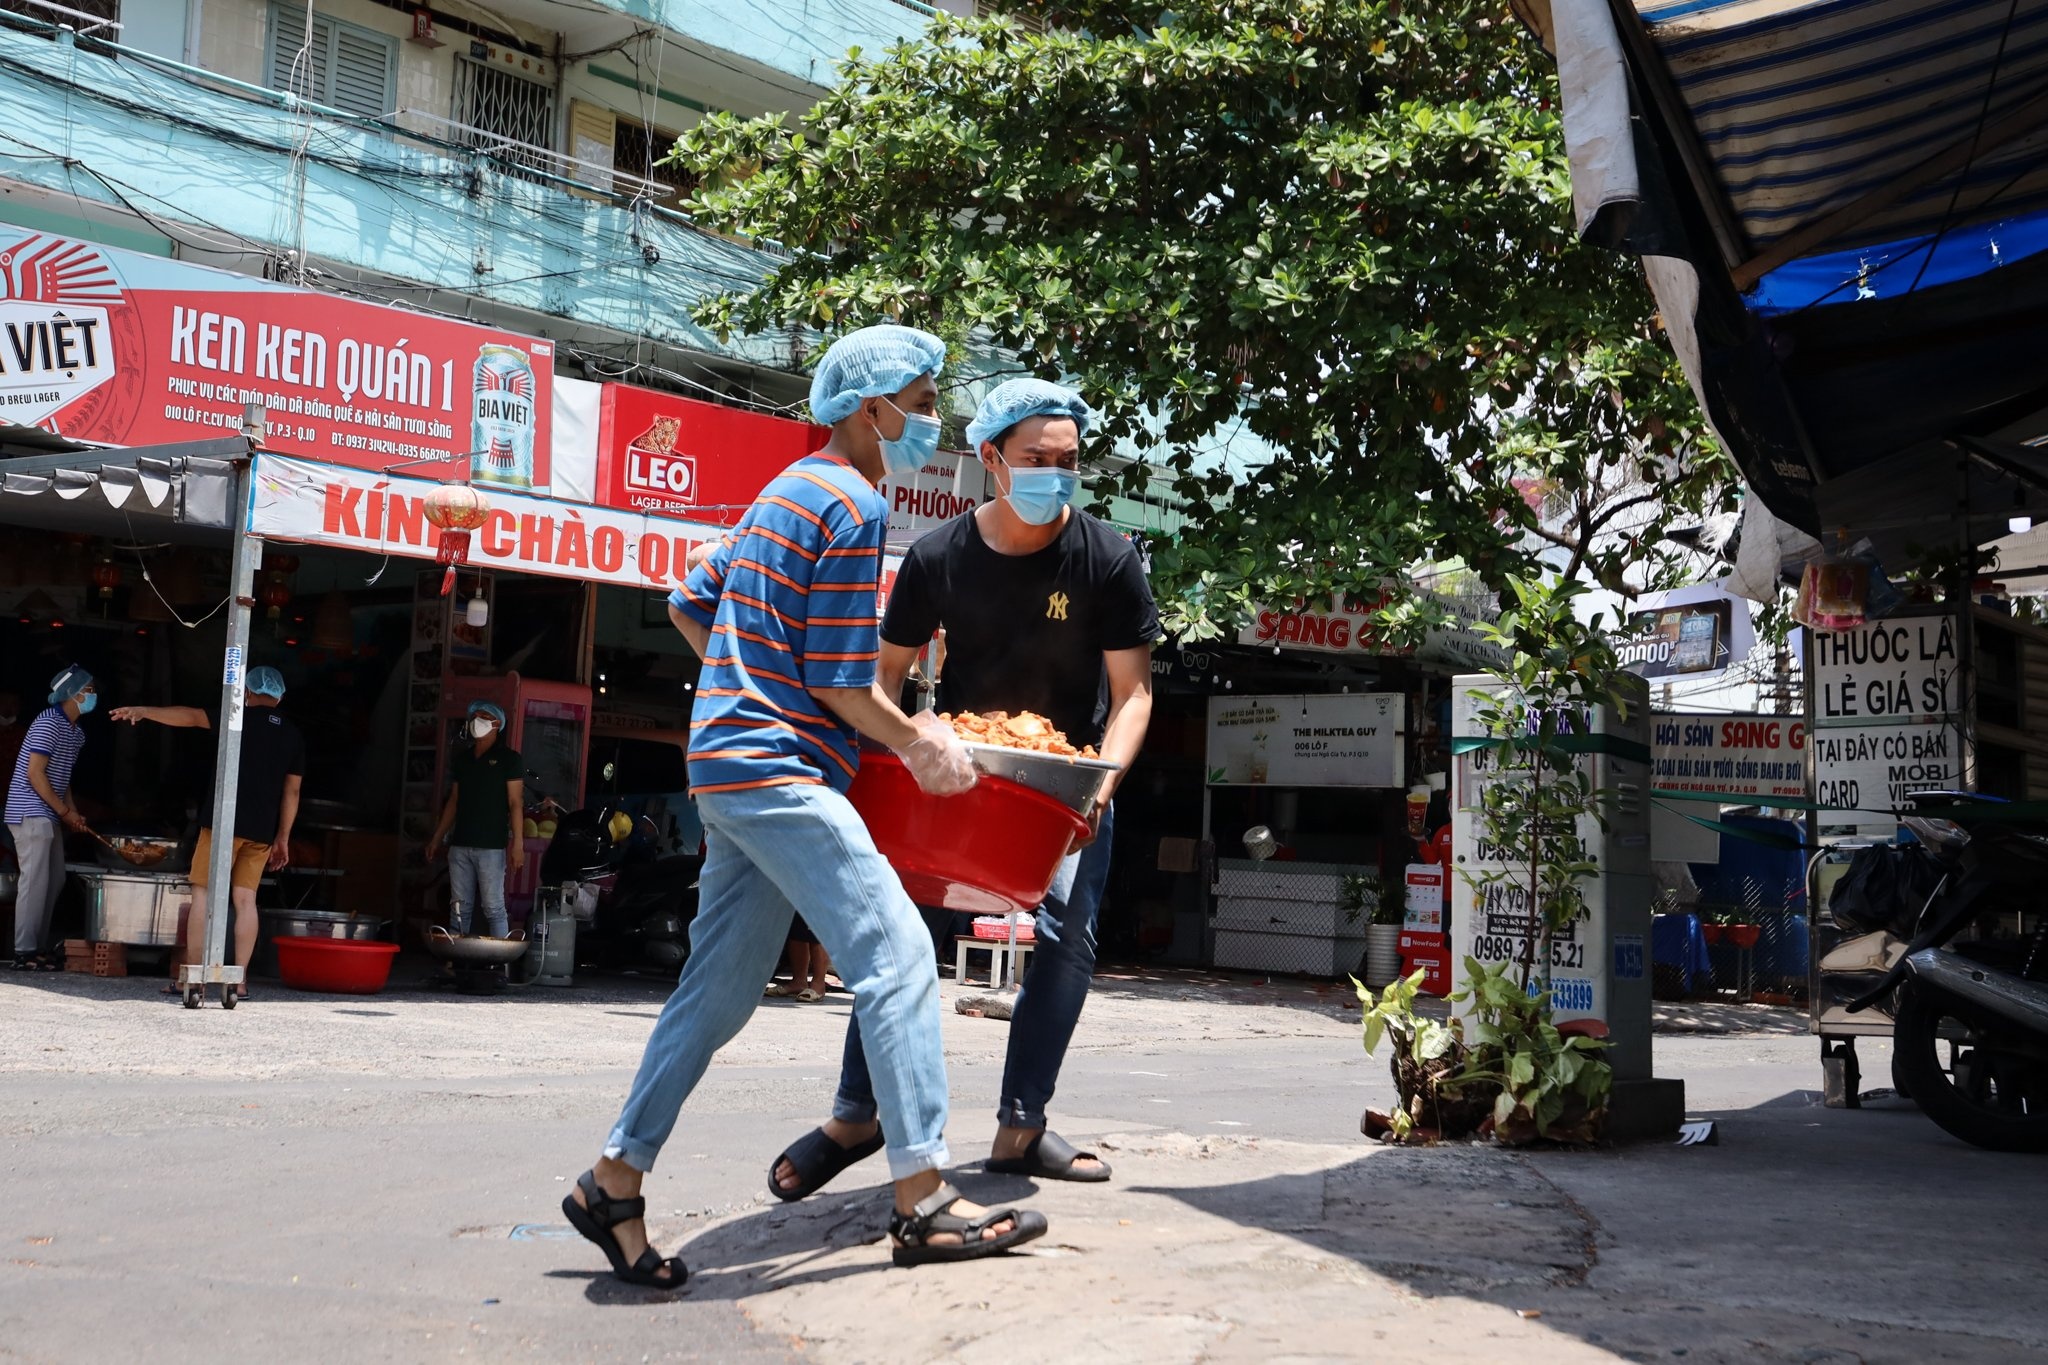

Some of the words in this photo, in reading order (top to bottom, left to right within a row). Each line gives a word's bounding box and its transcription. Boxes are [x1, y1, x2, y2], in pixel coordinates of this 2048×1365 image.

[5, 311, 99, 378] VIỆT
[170, 305, 246, 375] KEN
[256, 322, 327, 389] KEN
[337, 338, 432, 408] QUÁN
[441, 359, 453, 412] 1
[8, 395, 32, 405] BREW
[34, 391, 61, 403] LAGER
[168, 376, 198, 398] PHỤC
[200, 383, 214, 402] VỤ
[216, 384, 237, 403] CÁC
[239, 388, 264, 405] MÓN
[266, 392, 287, 412] DÂN
[289, 396, 303, 414] DÃ
[305, 397, 332, 419] ĐỒNG
[334, 404, 353, 424] QUÊ
[354, 409, 363, 423] &
[364, 408, 381, 428] HẢI
[383, 411, 402, 431] SẢN
[404, 417, 426, 435] TƯƠI
[479, 398, 500, 420] BIA
[501, 400, 529, 427] VIỆT
[165, 405, 181, 419] 010
[183, 406, 195, 422] LÔ
[196, 410, 202, 423] F
[225, 413, 244, 430] NGÔ
[277, 423, 291, 437] P.3
[297, 426, 316, 441] Q.10
[346, 434, 367, 450] 0937
[630, 453, 691, 493] LEO
[631, 494, 662, 509] LAGER
[664, 501, 686, 514] BEER
[480, 508, 625, 574] CHÀO
[1046, 591, 1070, 621] NY
[1255, 608, 1351, 650] SANG
[1816, 621, 1910, 666] THUỐC
[1919, 616, 1955, 660] LÁ
[1151, 661, 1173, 675] GUY
[1825, 673, 1858, 717] LẺ
[1866, 671, 1914, 715] GIÁ
[1922, 669, 1947, 713] SỈ
[1293, 727, 1312, 737] THE
[1313, 727, 1355, 737] MILKTEA
[1356, 727, 1377, 736] GUY
[1294, 742, 1310, 750] 006
[1311, 740, 1322, 750] LÔ
[1323, 742, 1328, 750] F
[1656, 718, 1680, 746] HẢI
[1684, 718, 1714, 747] SẢN
[1721, 721, 1780, 749] SANG
[1816, 738, 1841, 767] TẠI
[1845, 733, 1879, 762] ĐÂY
[1883, 731, 1907, 760] CÓ
[1912, 730, 1947, 759] BÁN
[1656, 758, 1675, 780] LOẠI
[1677, 753, 1692, 777] HẢI
[1694, 753, 1711, 778] SẢN
[1888, 764, 1949, 782] MOBI
[1819, 780, 1859, 808] CARD
[1412, 939, 1440, 948] NowFood
[1475, 934, 1583, 968] 0989.2.5.21
